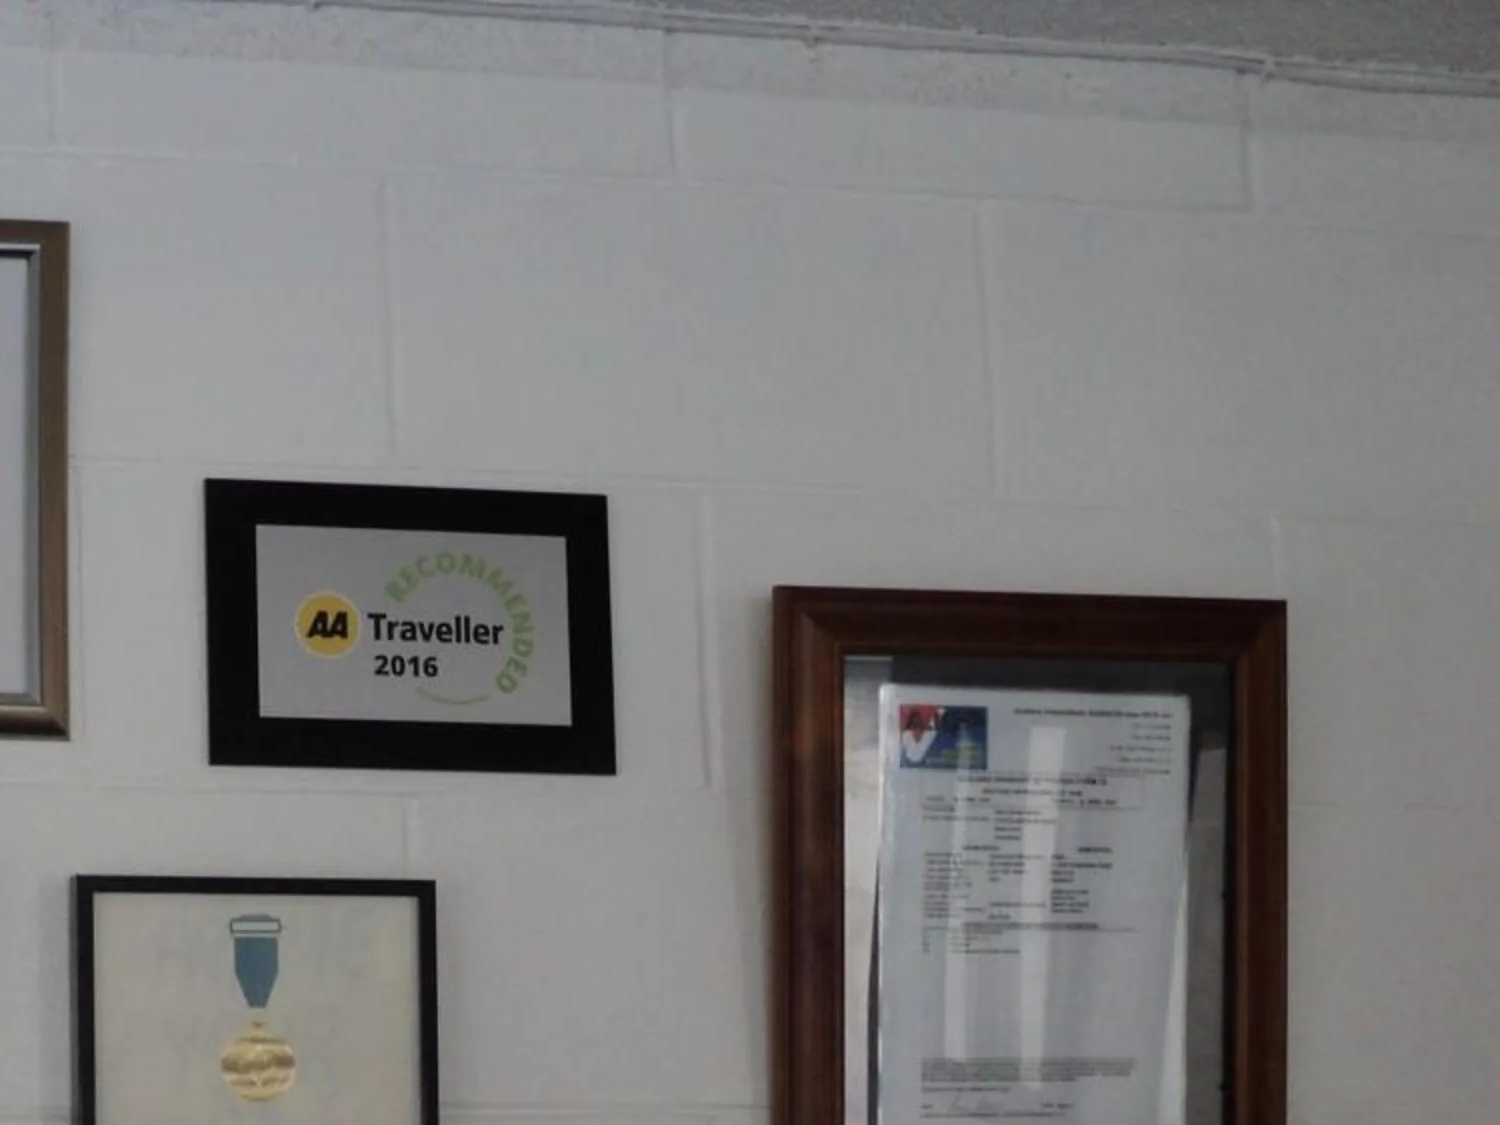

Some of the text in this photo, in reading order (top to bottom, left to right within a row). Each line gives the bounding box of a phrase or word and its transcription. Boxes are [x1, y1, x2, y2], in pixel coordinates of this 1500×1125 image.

[307, 610, 504, 645] AA Traveller
[384, 551, 535, 694] RECOMMENDED
[374, 654, 439, 678] 2016
